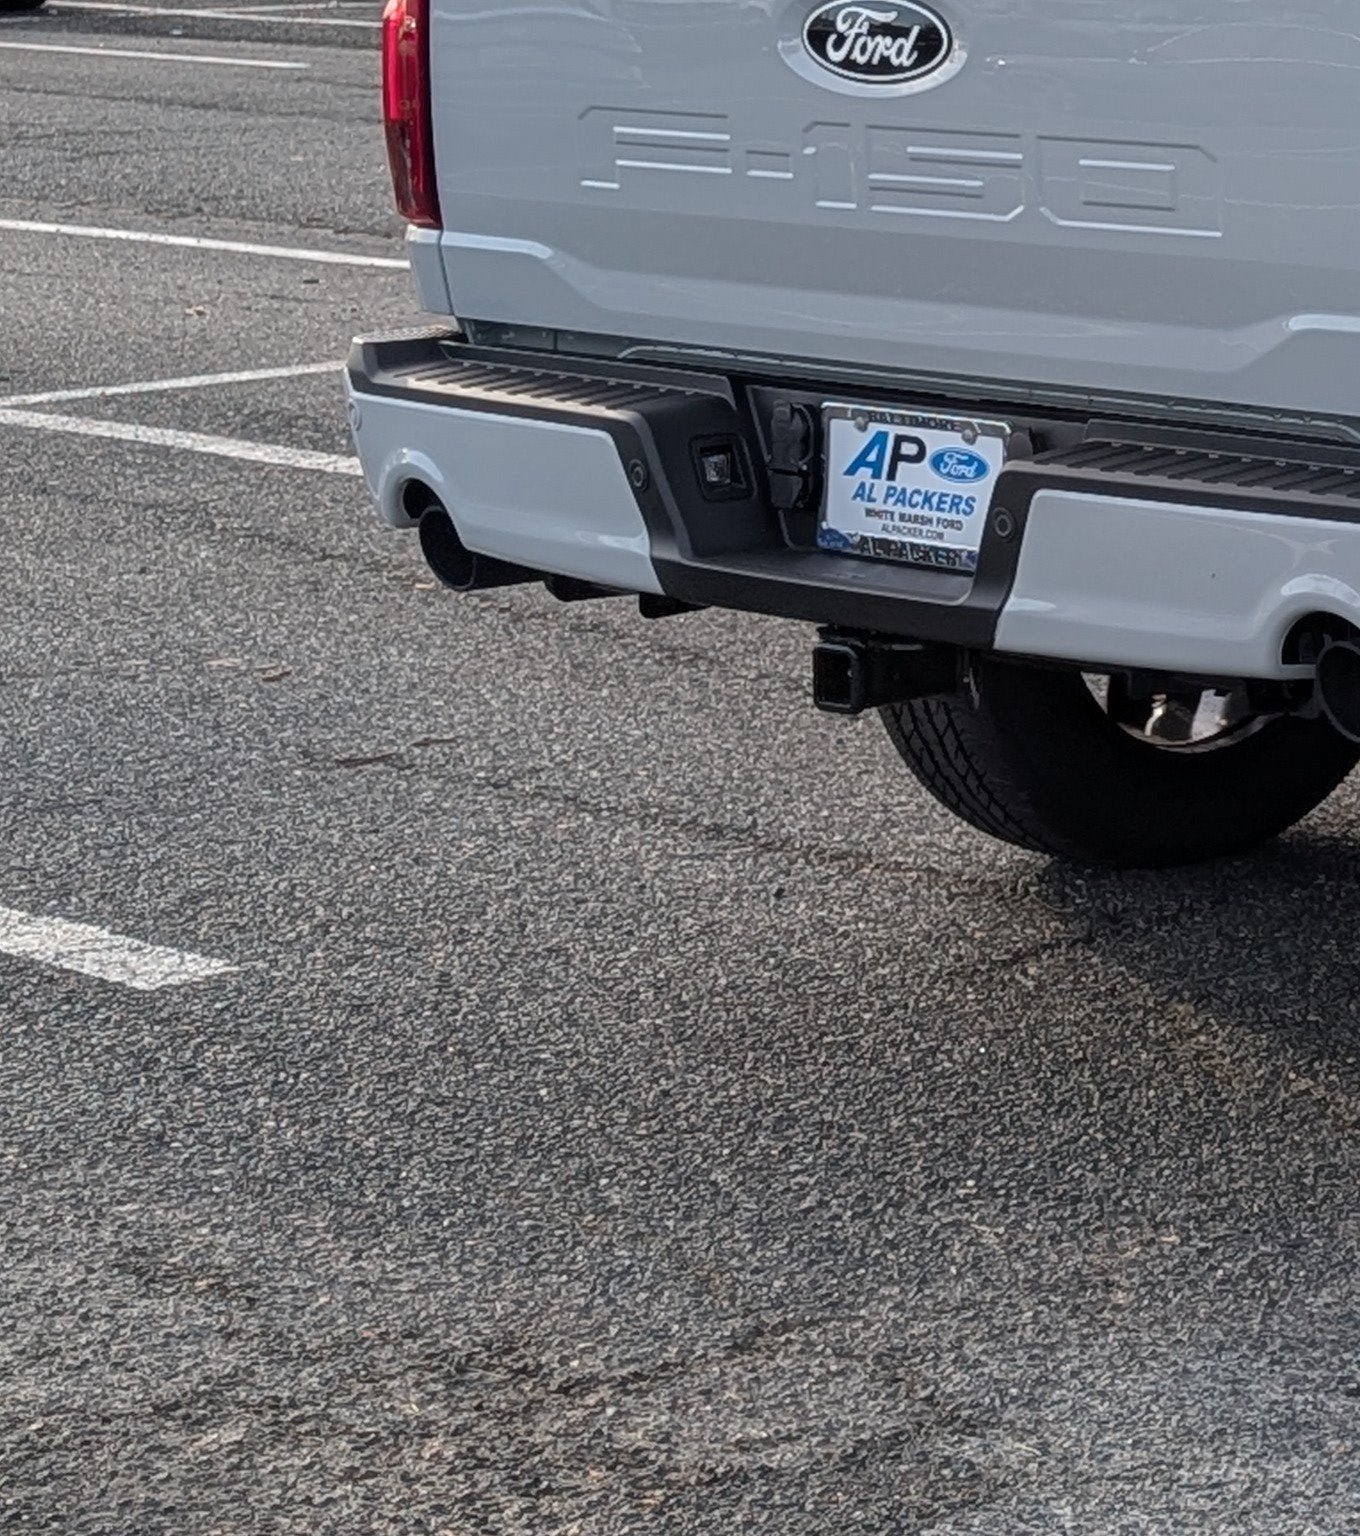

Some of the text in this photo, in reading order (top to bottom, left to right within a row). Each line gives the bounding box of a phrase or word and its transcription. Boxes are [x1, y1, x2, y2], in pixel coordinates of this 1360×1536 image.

[825, 5, 921, 69] Ford
[577, 105, 1224, 238] F-150
[843, 430, 927, 482] AP
[938, 452, 979, 479] Ford
[851, 481, 977, 517] AL PACKERS
[865, 507, 964, 531] WHITE MARSH FORD
